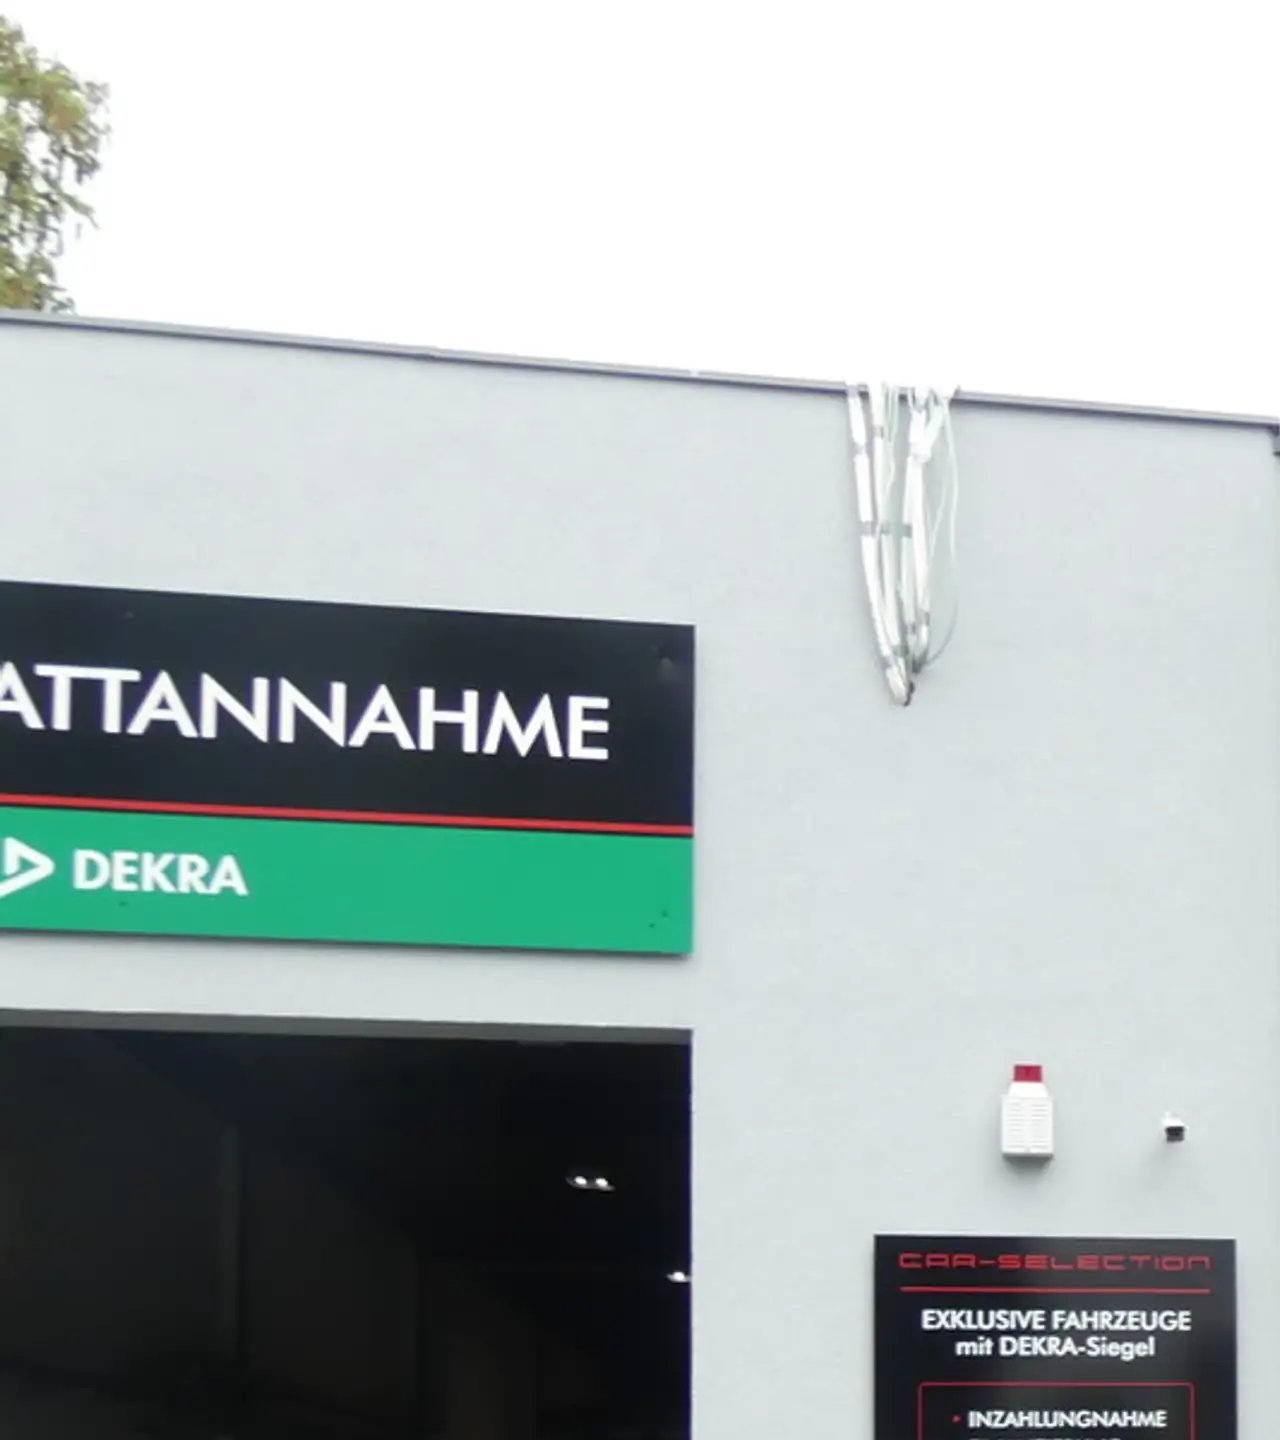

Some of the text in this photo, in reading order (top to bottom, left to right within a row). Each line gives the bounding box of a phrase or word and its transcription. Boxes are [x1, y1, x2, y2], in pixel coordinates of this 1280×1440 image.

[0, 661, 611, 761] ATTANNAHME
[73, 849, 249, 896] DEKRA
[898, 1252, 1211, 1271] CAR-SELECTION
[921, 1309, 1192, 1331] EXKLUSIVE FAHRZEUGE
[955, 1335, 1156, 1362] mit DEKRA-Siegel
[968, 1409, 1168, 1429] INZAHLUNGNAHME
